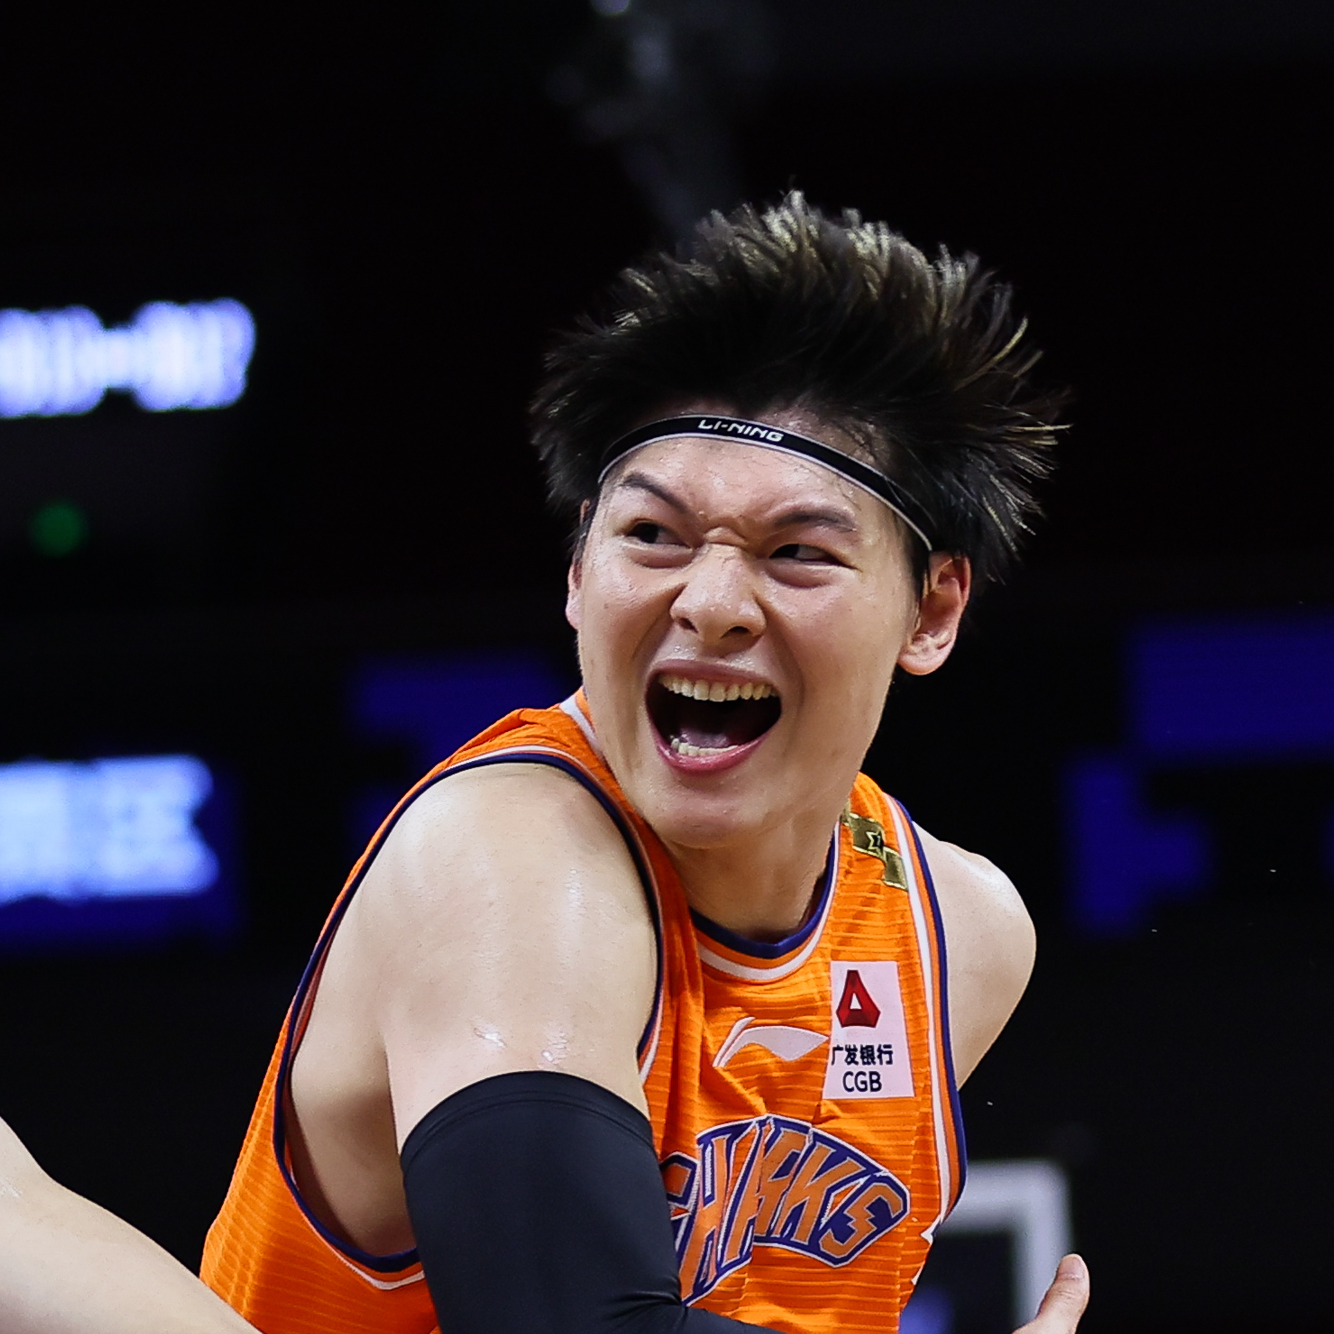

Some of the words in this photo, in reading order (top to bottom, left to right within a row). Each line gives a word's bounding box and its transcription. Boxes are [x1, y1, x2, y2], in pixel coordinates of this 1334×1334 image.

[698, 419, 784, 442] LI-NING
[831, 1044, 893, 1065] 广发银行
[843, 1071, 882, 1092] CGB
